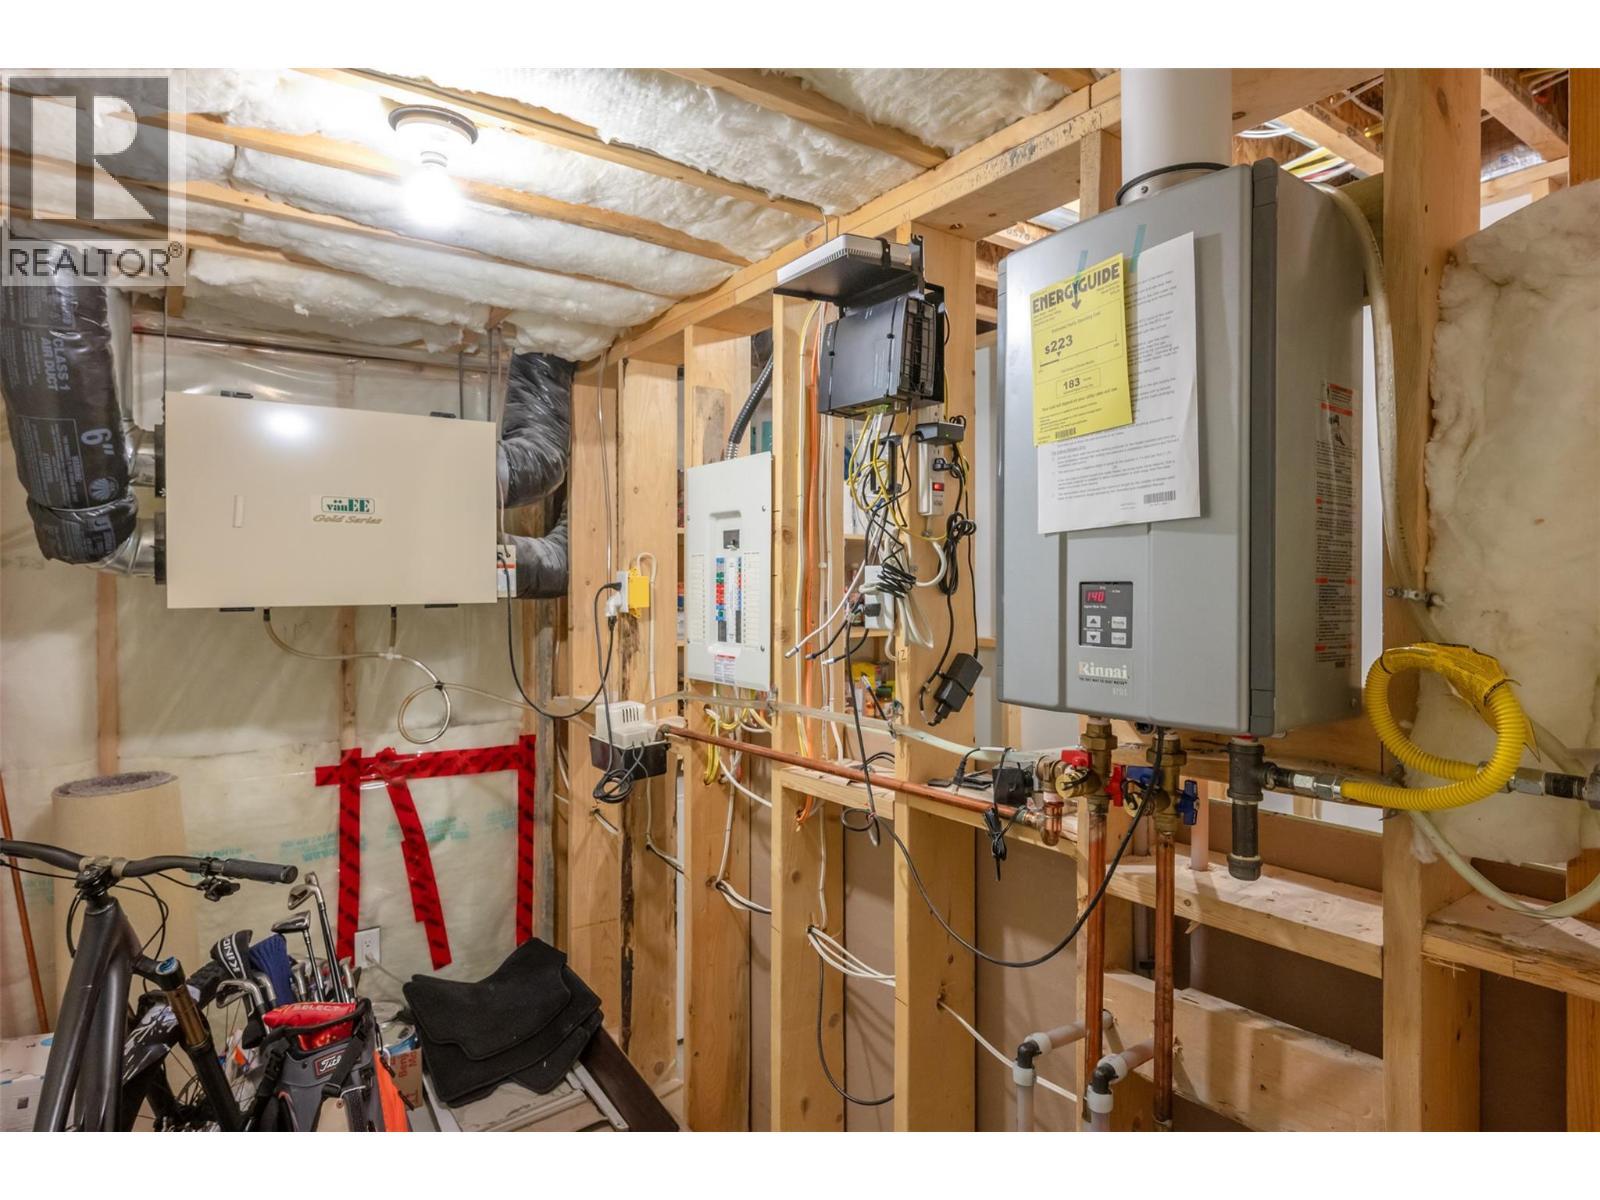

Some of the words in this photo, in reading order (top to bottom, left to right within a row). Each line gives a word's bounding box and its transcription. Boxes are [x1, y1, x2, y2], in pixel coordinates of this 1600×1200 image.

[41, 336, 54, 358] AIR
[1044, 334, 1073, 355] $223
[52, 338, 69, 381] CLASS
[44, 360, 59, 392] DUCT
[1063, 377, 1081, 390] 183
[313, 515, 345, 523] Gold
[345, 515, 383, 524] Series
[1087, 591, 1105, 602] 140
[1078, 661, 1128, 680] Rinnai
